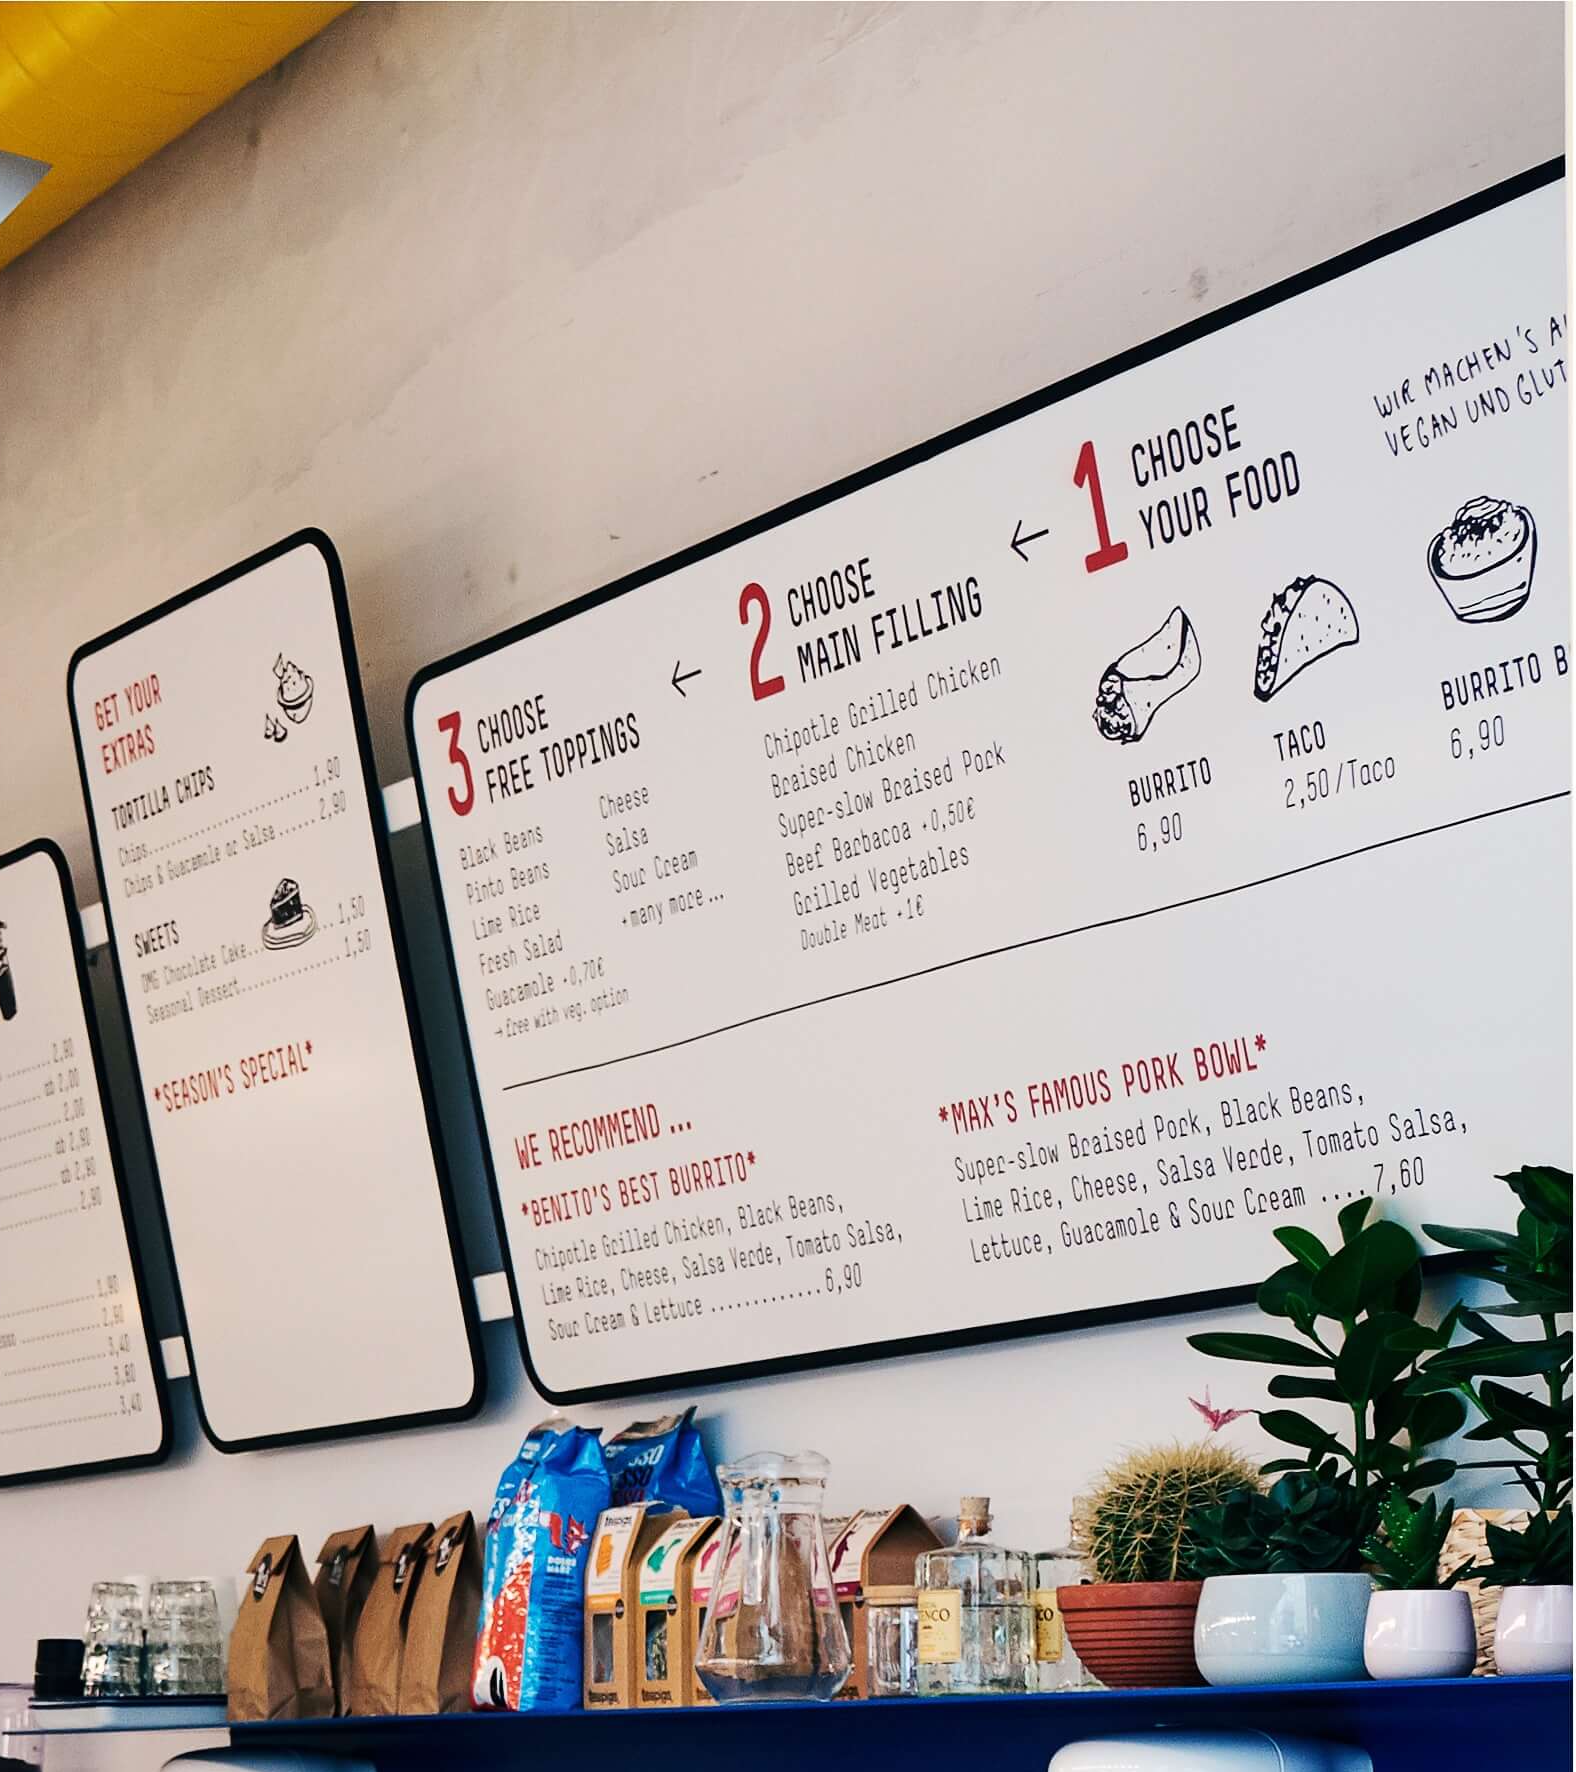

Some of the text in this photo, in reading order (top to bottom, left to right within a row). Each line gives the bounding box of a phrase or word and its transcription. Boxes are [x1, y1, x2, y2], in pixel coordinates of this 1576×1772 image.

[1373, 378, 1415, 418] WIR
[1424, 325, 1539, 395] MACHEN'S
[1131, 404, 1241, 487] CHOOSE
[1384, 406, 1458, 457] VEGAN
[1465, 387, 1511, 423] UND
[1074, 440, 1128, 574] 1
[1138, 450, 1301, 550] YOUR FOOD
[787, 557, 875, 627] CHOOSE
[739, 582, 785, 702] 2
[797, 576, 983, 684] MAIN FILLING
[95, 673, 162, 731] GET YOUR
[764, 656, 1001, 761] Chipotle Grilled Chicken
[1440, 652, 1543, 711] BURRITO
[102, 723, 155, 774] EXTRAS
[477, 694, 549, 753] CHOOSE
[1273, 720, 1327, 761] TACO
[1450, 714, 1506, 760] 6,90
[314, 755, 341, 787] 1,90
[438, 710, 474, 816] 3
[485, 712, 641, 804] FREE TOPPINGS
[771, 732, 916, 799] Braised Chicken
[778, 741, 1006, 839] Super-slow Braised Pork
[1128, 756, 1213, 808] BURRITO
[111, 765, 215, 831] TORTILLA CHIPS
[599, 786, 650, 820] Cheese
[459, 825, 544, 871] Black Beans
[606, 826, 649, 857] Salsa
[785, 842, 824, 877] Beef
[832, 821, 912, 862] Barbacoa
[1136, 811, 1184, 853] 6,90
[466, 862, 551, 905] Pinto Beans
[612, 850, 698, 894] Sour Cream
[793, 846, 970, 917] Grilled Vegetables
[135, 919, 180, 958] SWEETS
[163, 952, 217, 986] Chocolate
[220, 942, 247, 965] Cake
[338, 895, 366, 924] 1,50
[471, 902, 542, 942] Lime Rice
[479, 928, 563, 976] Fresh Salad
[800, 919, 847, 951] Double
[854, 905, 888, 935] Meat
[146, 928, 372, 1025] Seasonal Dessert 1,50
[486, 972, 555, 1012] Guacamole
[506, 1017, 530, 1039] free
[534, 1004, 559, 1030] with
[591, 986, 630, 1017] option
[1027, 1068, 1112, 1118] FAMOUS
[1122, 1052, 1184, 1097] PORK
[515, 1103, 661, 1170] WE RECOMMEND
[954, 1082, 1365, 1185] Super-slow Braised Pork, Black Beans,
[961, 1107, 1468, 1223] Lime Rice, Cheese, Salsa Verde, Tomato Salsa,
[618, 1171, 660, 1208] BEST
[969, 1156, 1425, 1264] Lettuce, Guacamole & Sour Cream 7,60
[535, 1192, 845, 1272] Chipotle Grilled Chicken, Black Beans,
[542, 1219, 904, 1306] Lime Rice, Cheese, Salsa Verde, Tomato Salsa,
[548, 1262, 863, 1342] Sour Cream & Lettuce 6,90
